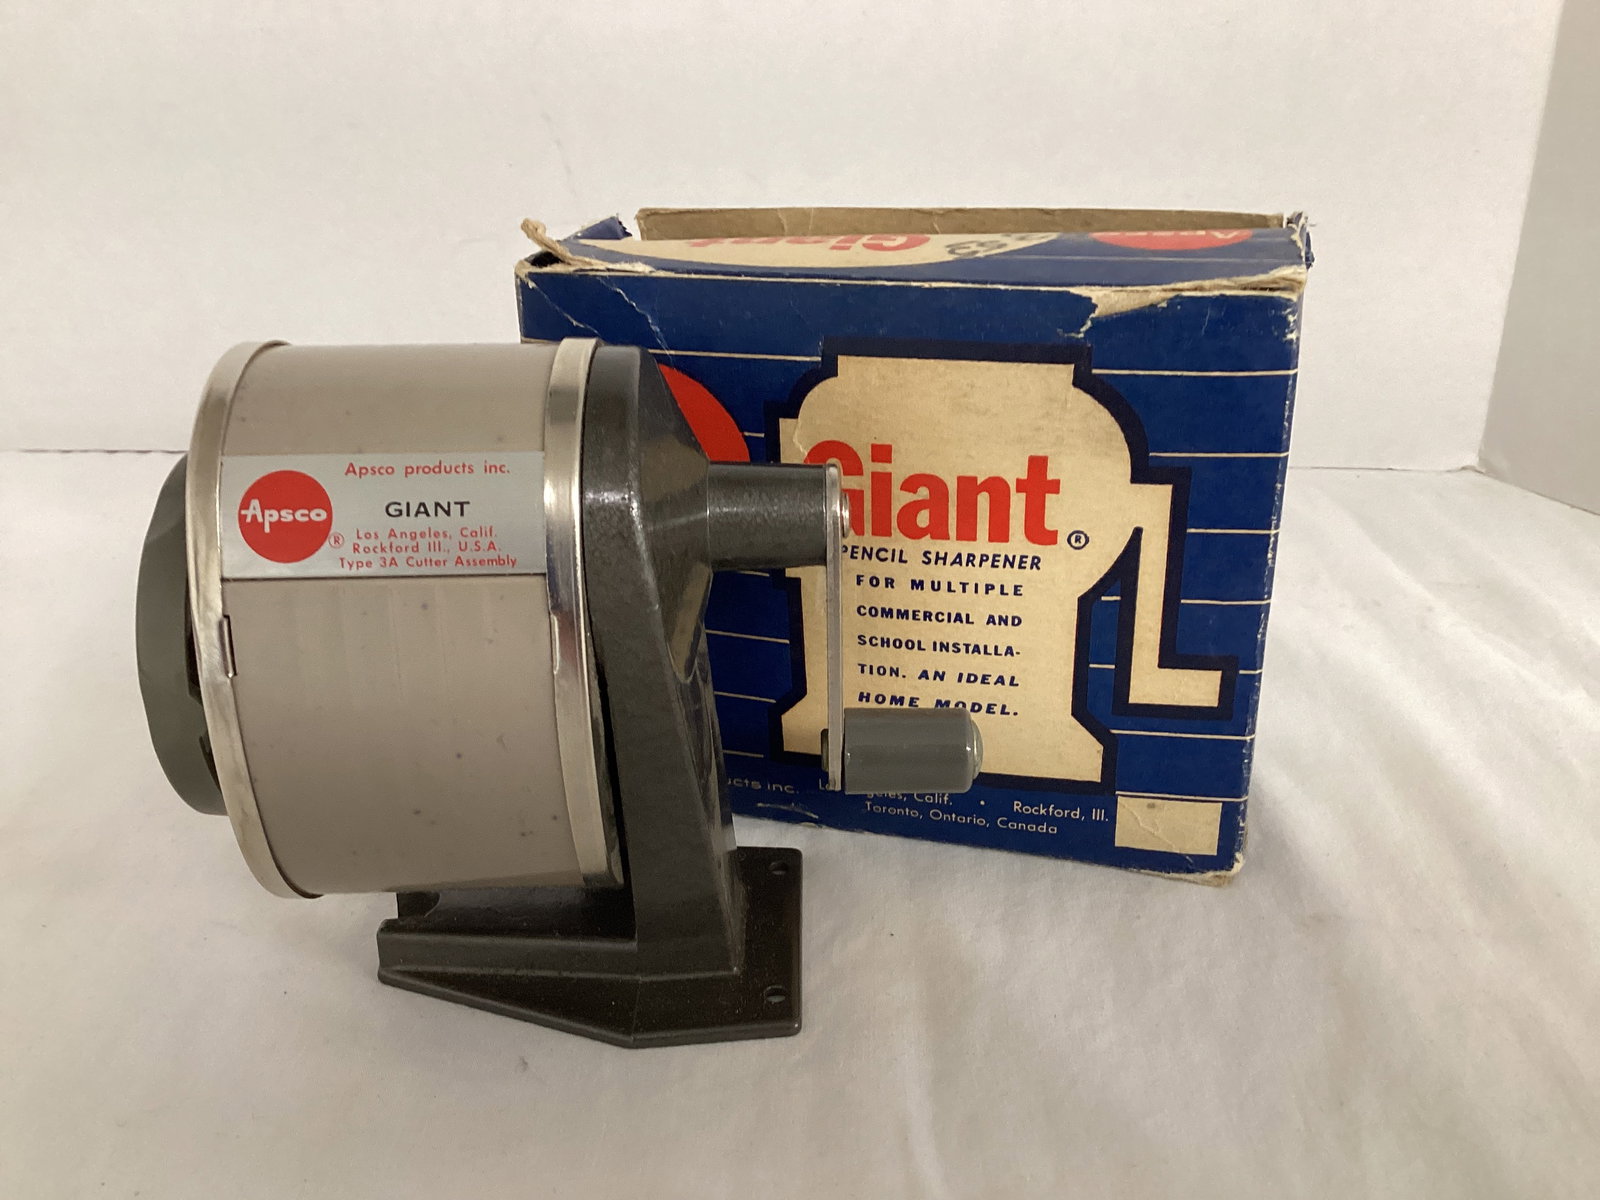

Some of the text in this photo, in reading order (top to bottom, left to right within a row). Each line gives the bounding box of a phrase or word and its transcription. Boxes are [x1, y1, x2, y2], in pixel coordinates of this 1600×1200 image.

[344, 459, 511, 479] Apsco products inc.
[803, 440, 1060, 546] Giant
[240, 498, 328, 533] Apsco
[384, 501, 471, 518] GIANT
[356, 525, 498, 541] Los Angeles, Calif.
[352, 541, 420, 554] Rockford
[338, 553, 517, 571] Type 3A Cutter Assembly
[921, 550, 1042, 571] SHARPENER
[856, 574, 1024, 597] FOR MULTIPLE
[856, 604, 1023, 627] COMMERCIAL AND
[857, 634, 1021, 657] SCHOOL INSTALLA-
[857, 663, 1020, 687] TION. AN IDEAL
[858, 691, 1019, 716] HOME MODEL.
[865, 801, 1058, 834] Toronto, Ontario, Canada
[1013, 800, 1086, 821] Rockford,
